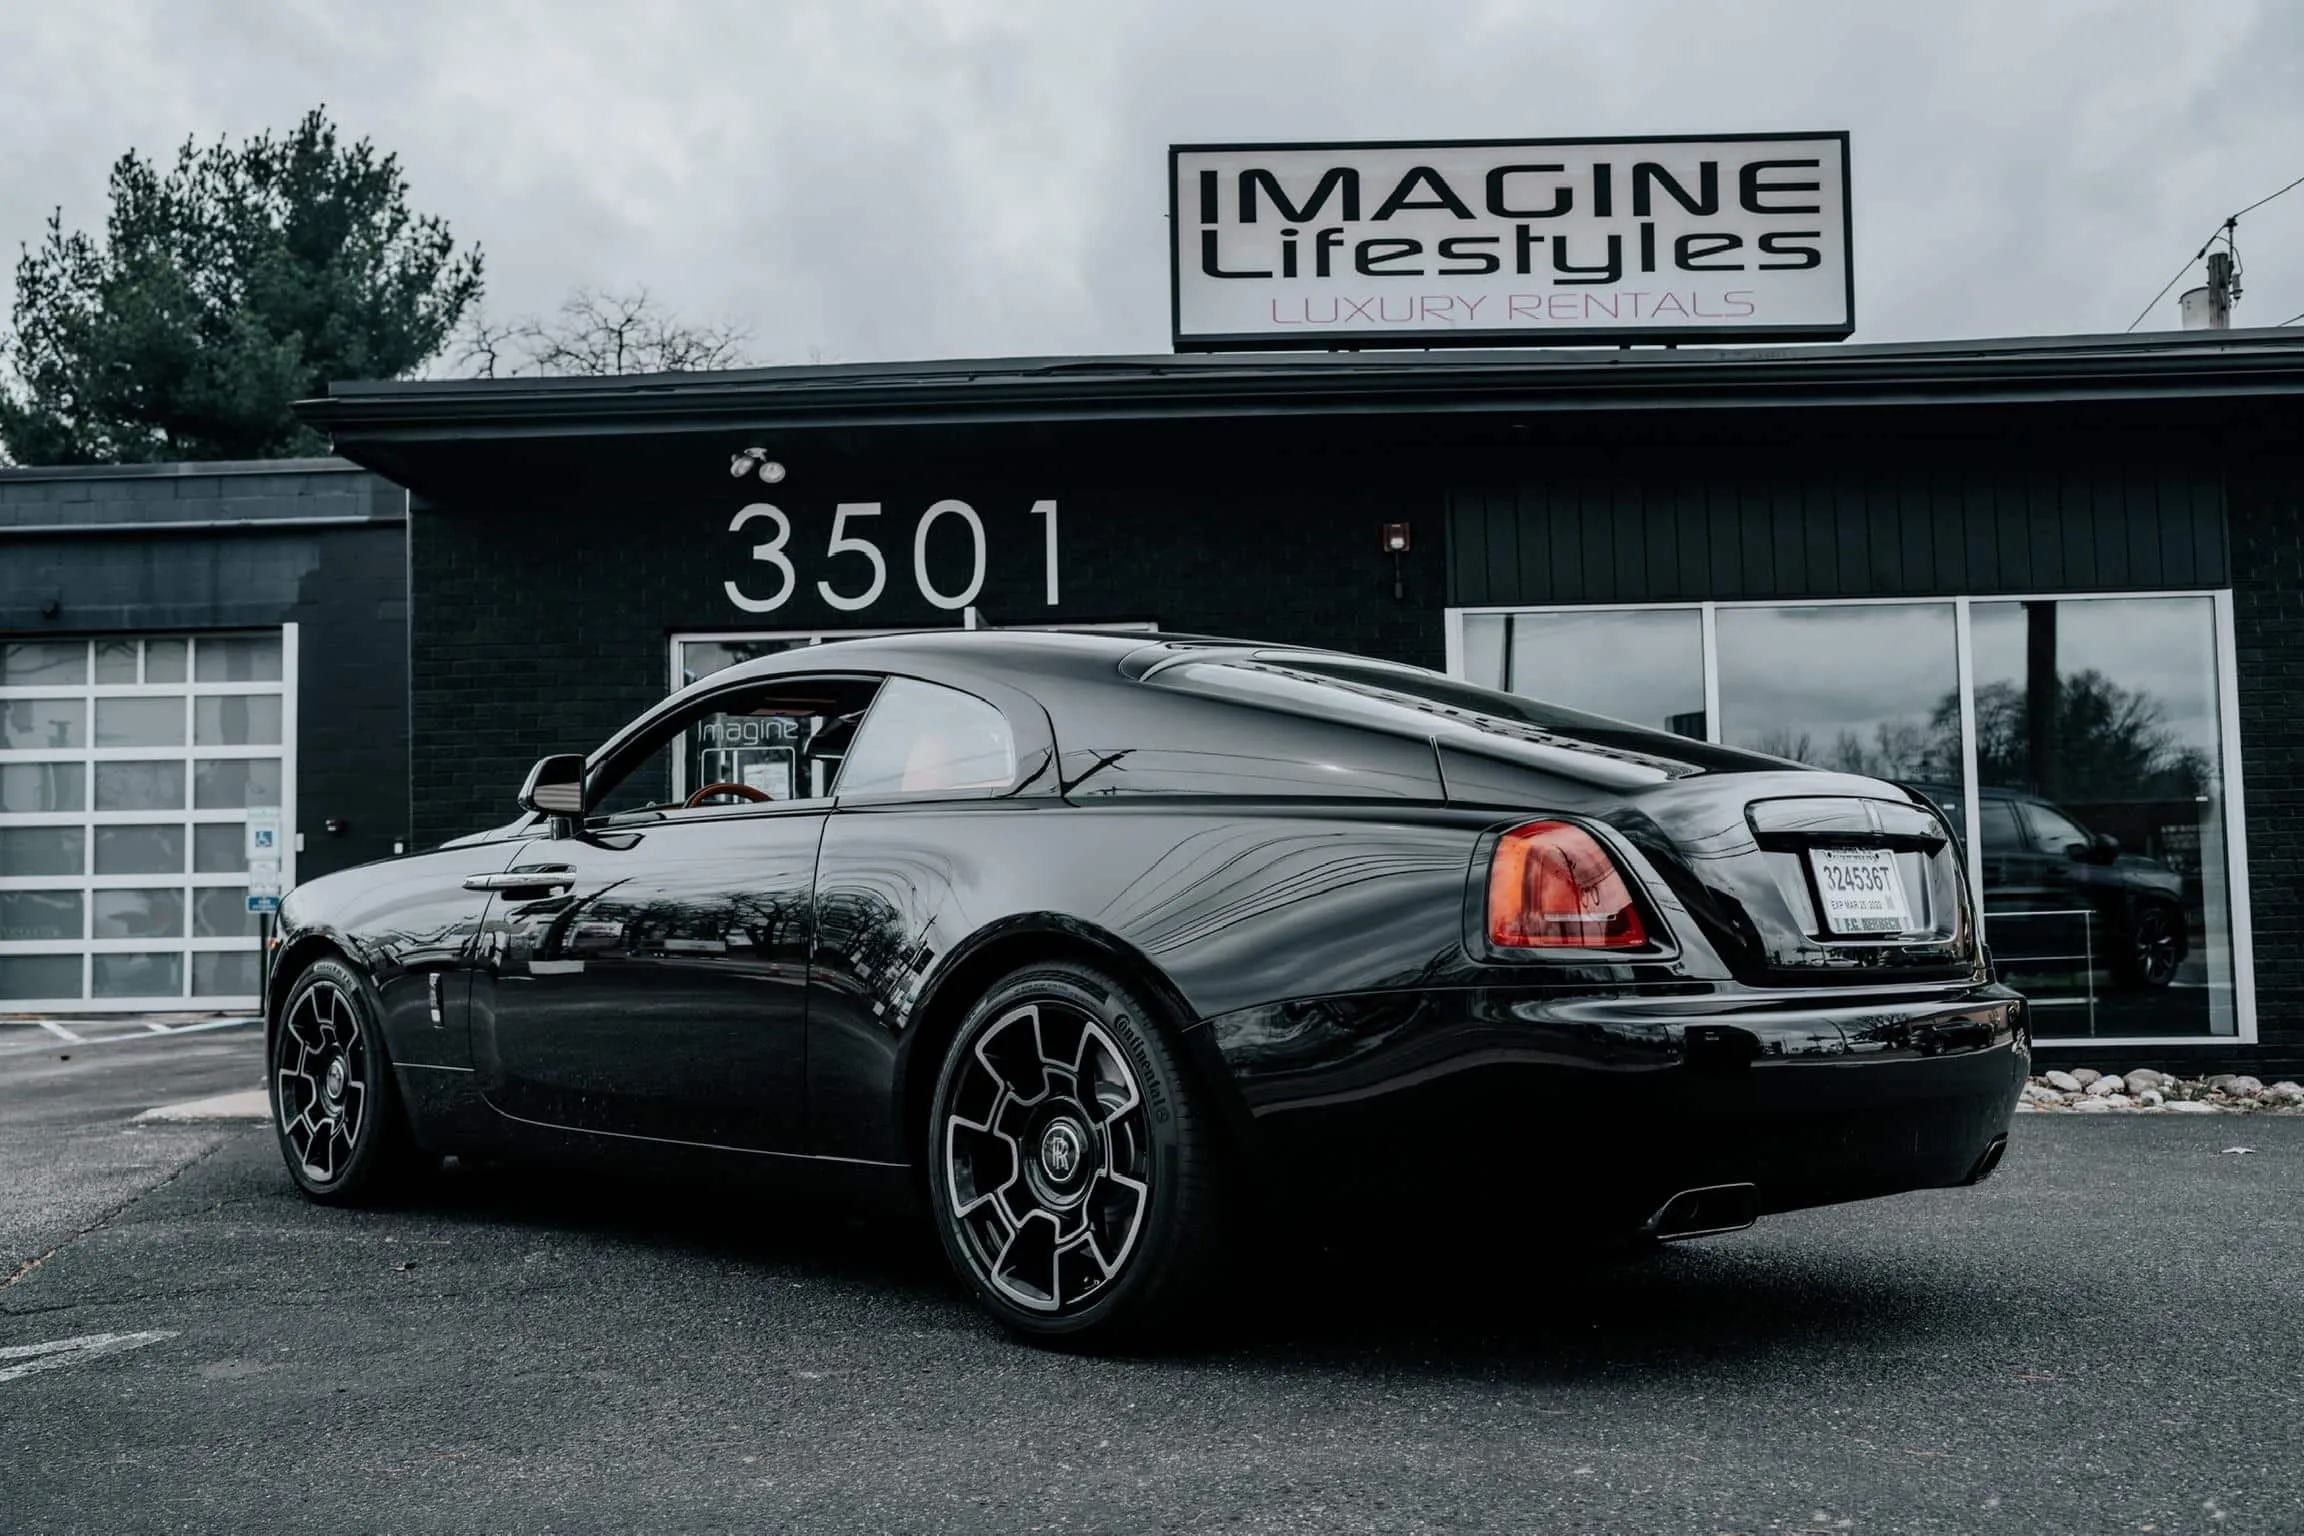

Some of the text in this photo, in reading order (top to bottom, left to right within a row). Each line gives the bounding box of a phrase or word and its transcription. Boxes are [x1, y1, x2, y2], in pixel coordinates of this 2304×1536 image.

[1200, 158, 1821, 225] IMAGINE
[1200, 222, 1822, 286] Lifestyles
[1271, 290, 1756, 325] LUXURY RENTALS
[723, 499, 1060, 613] 3501
[697, 719, 799, 746] Imagine
[1823, 865, 1893, 892] 324536T
[1113, 1013, 1167, 1107] Continental
